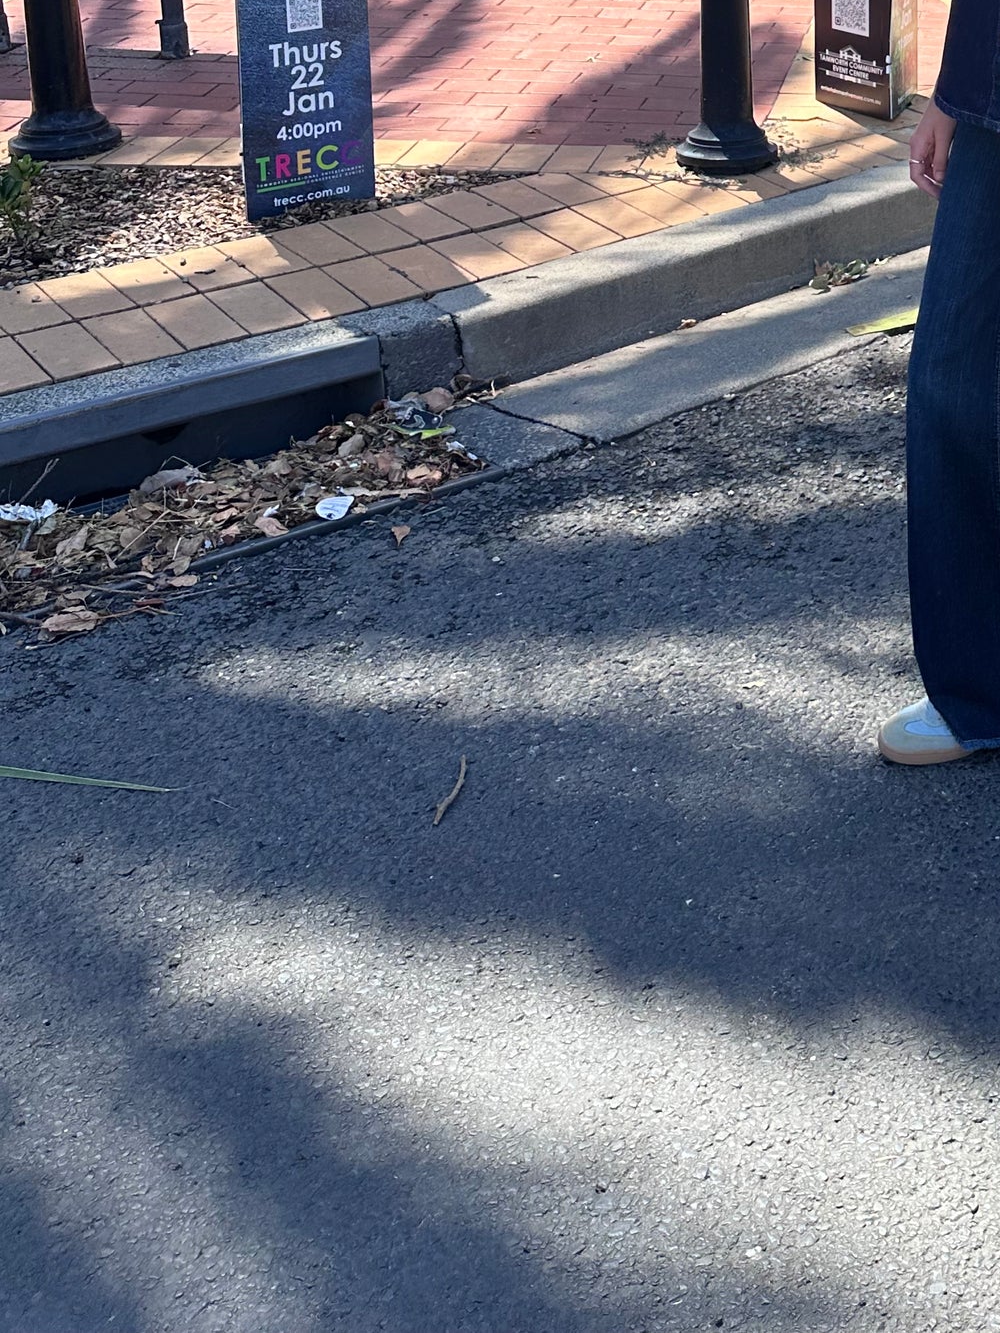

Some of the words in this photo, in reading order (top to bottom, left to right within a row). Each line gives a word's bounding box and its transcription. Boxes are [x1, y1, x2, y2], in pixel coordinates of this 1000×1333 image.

[269, 39, 343, 68] Thurs
[819, 53, 849, 67] TAMWORTH
[849, 61, 884, 76] COMMUNITY
[290, 63, 325, 91] 22
[832, 64, 849, 75] EVENT
[848, 68, 870, 80] CENTRE
[282, 91, 335, 117] Jan
[276, 120, 342, 143] 4:00pm
[273, 184, 351, 208] trecc.com.au
